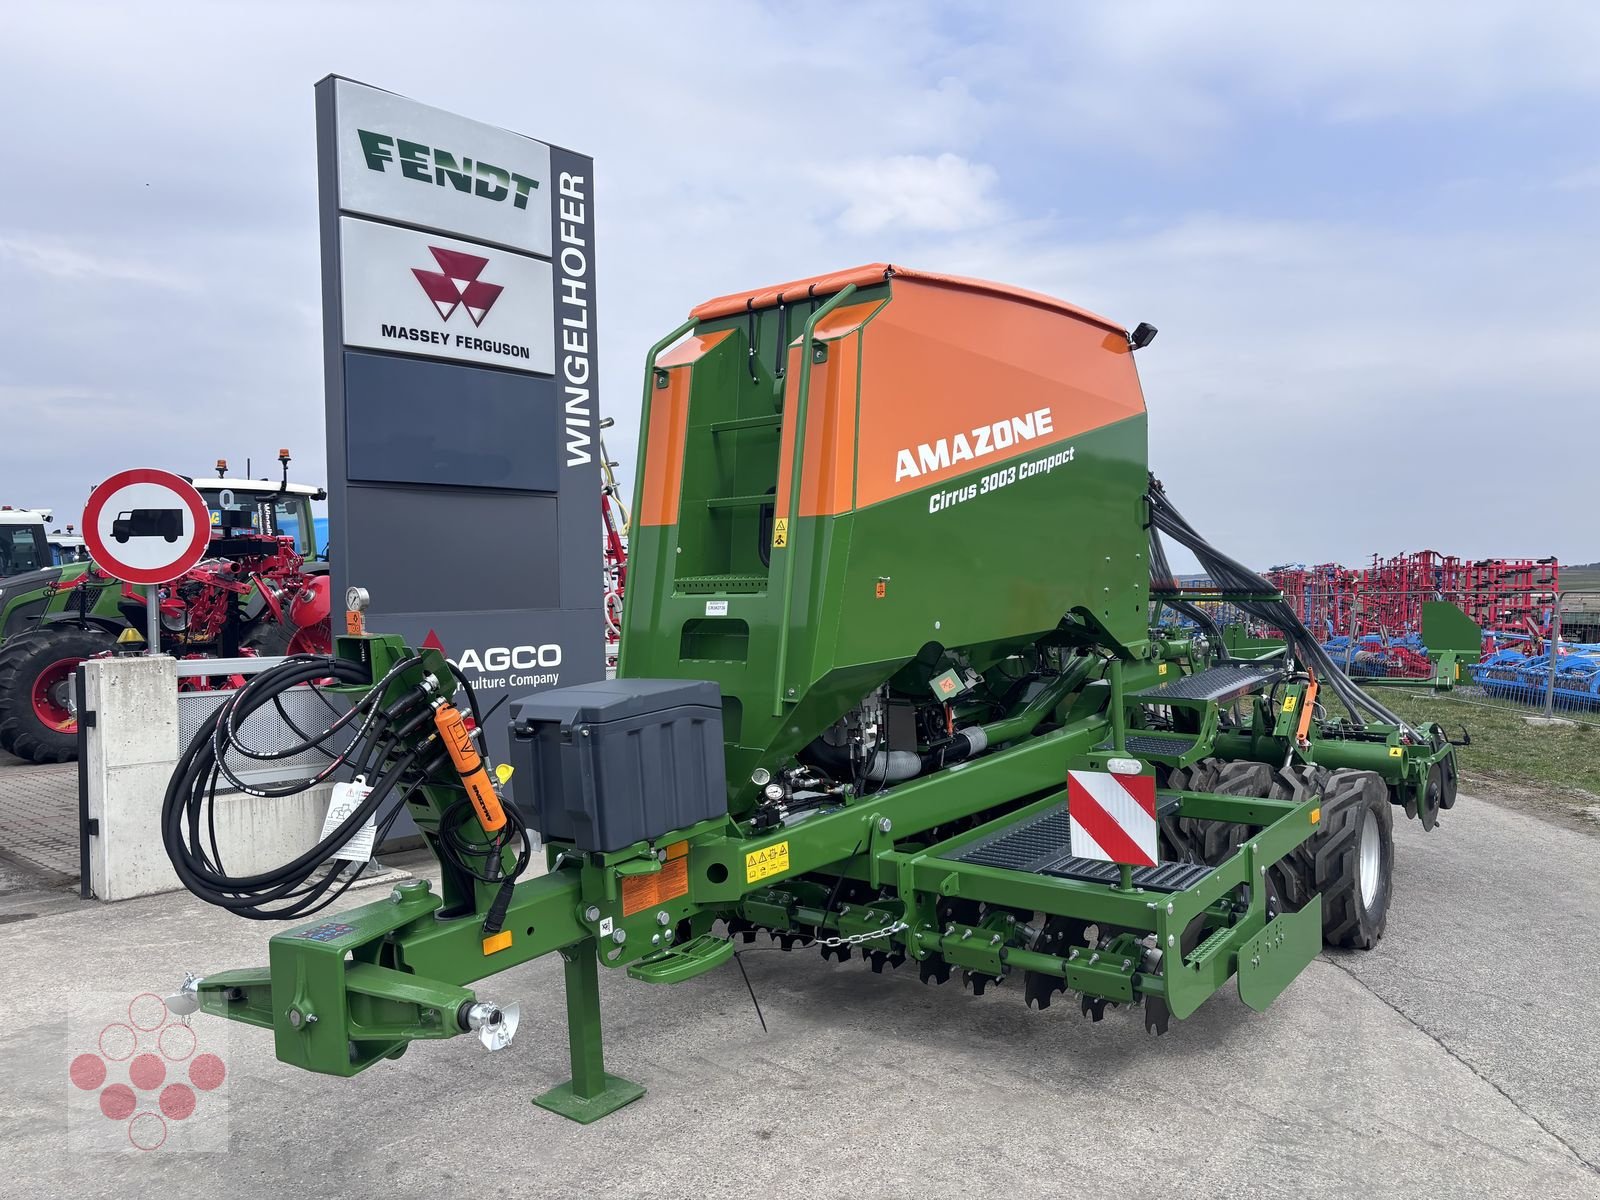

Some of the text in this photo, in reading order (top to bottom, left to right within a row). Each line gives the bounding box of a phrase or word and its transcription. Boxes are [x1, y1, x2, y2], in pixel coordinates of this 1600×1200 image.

[357, 128, 540, 210] FENDT
[381, 323, 530, 359] MASSEY FERGUSON
[559, 171, 592, 467] WINGELHOFER
[895, 407, 1054, 483] AMAZONE
[929, 446, 1075, 514] Cirrus 3003 Compact
[458, 643, 562, 672] AGCO
[509, 673, 559, 688] Company
